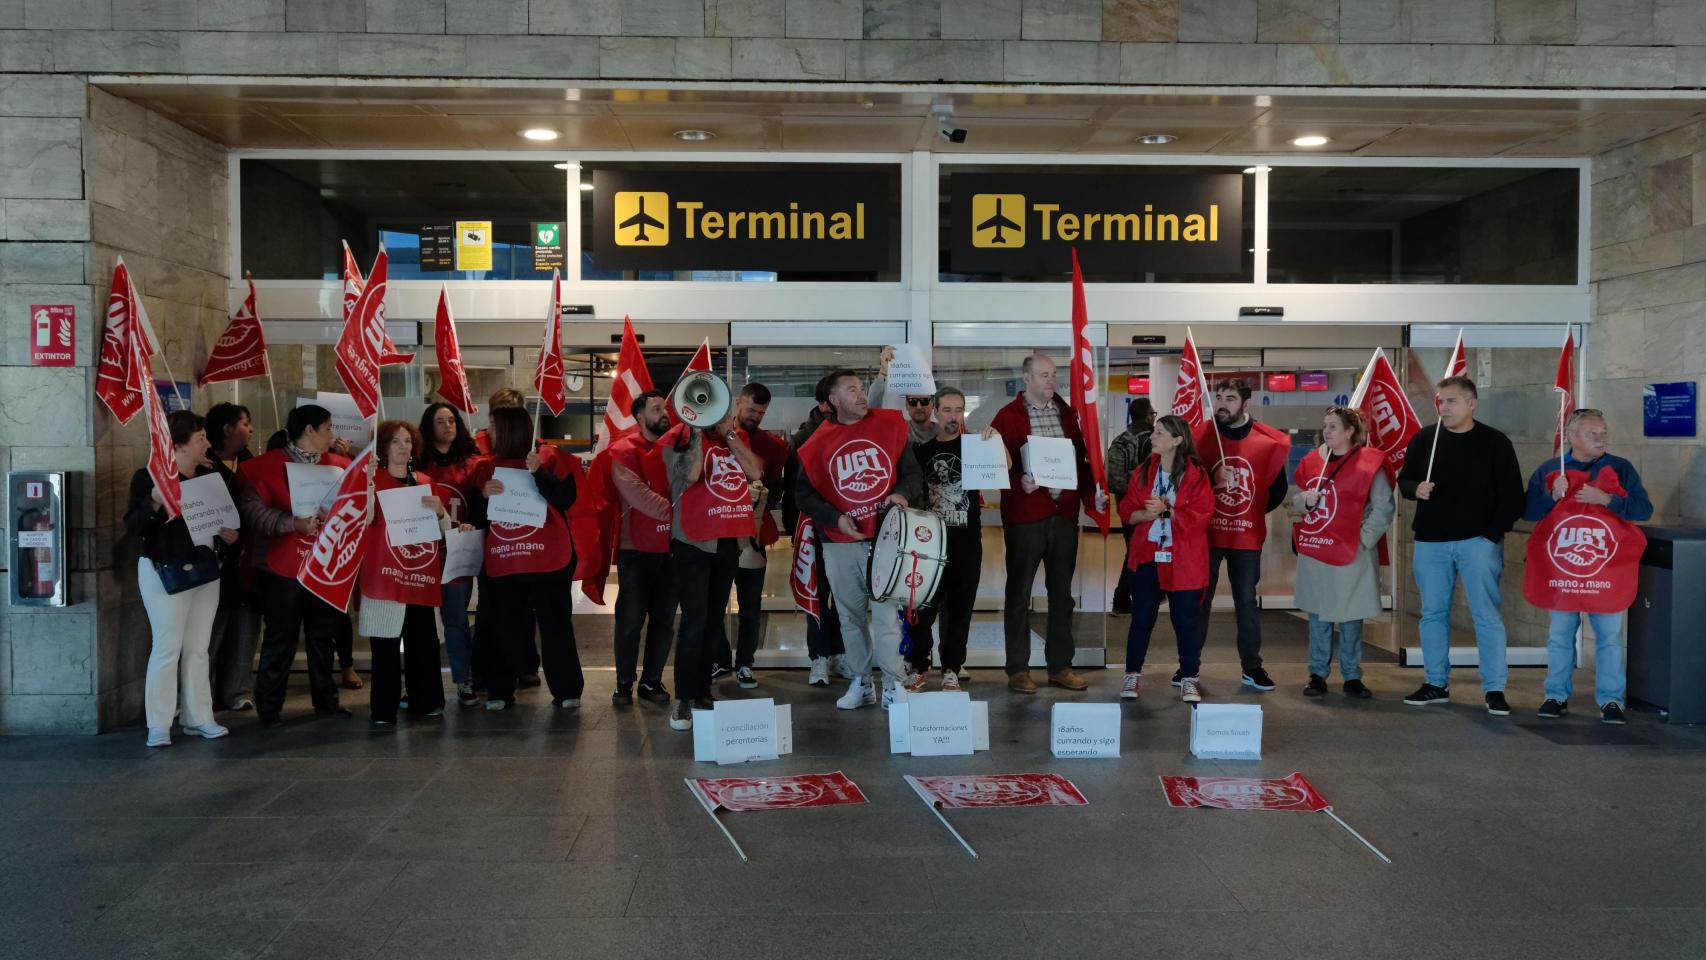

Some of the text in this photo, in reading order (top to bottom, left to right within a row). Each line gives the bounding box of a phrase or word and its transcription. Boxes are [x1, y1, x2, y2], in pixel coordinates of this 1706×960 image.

[676, 201, 865, 239] Terminal
[1033, 203, 1219, 241] Terminal
[34, 352, 71, 360] EXTINTOR
[836, 448, 885, 479] UGT
[708, 505, 732, 516] mano
[1234, 519, 1253, 528] mano
[313, 498, 363, 566] UGT
[1309, 536, 1334, 546] mano
[1557, 528, 1606, 550] UGT
[490, 544, 511, 554] mano
[516, 542, 545, 551] mano
[795, 523, 815, 586] UGT
[410, 573, 436, 585] mano
[1548, 580, 1578, 588] mano
[1586, 580, 1611, 589] mano
[912, 724, 968, 732] Transformaciones
[1056, 736, 1116, 746] currando y sigo
[1057, 748, 1099, 756] esperando
